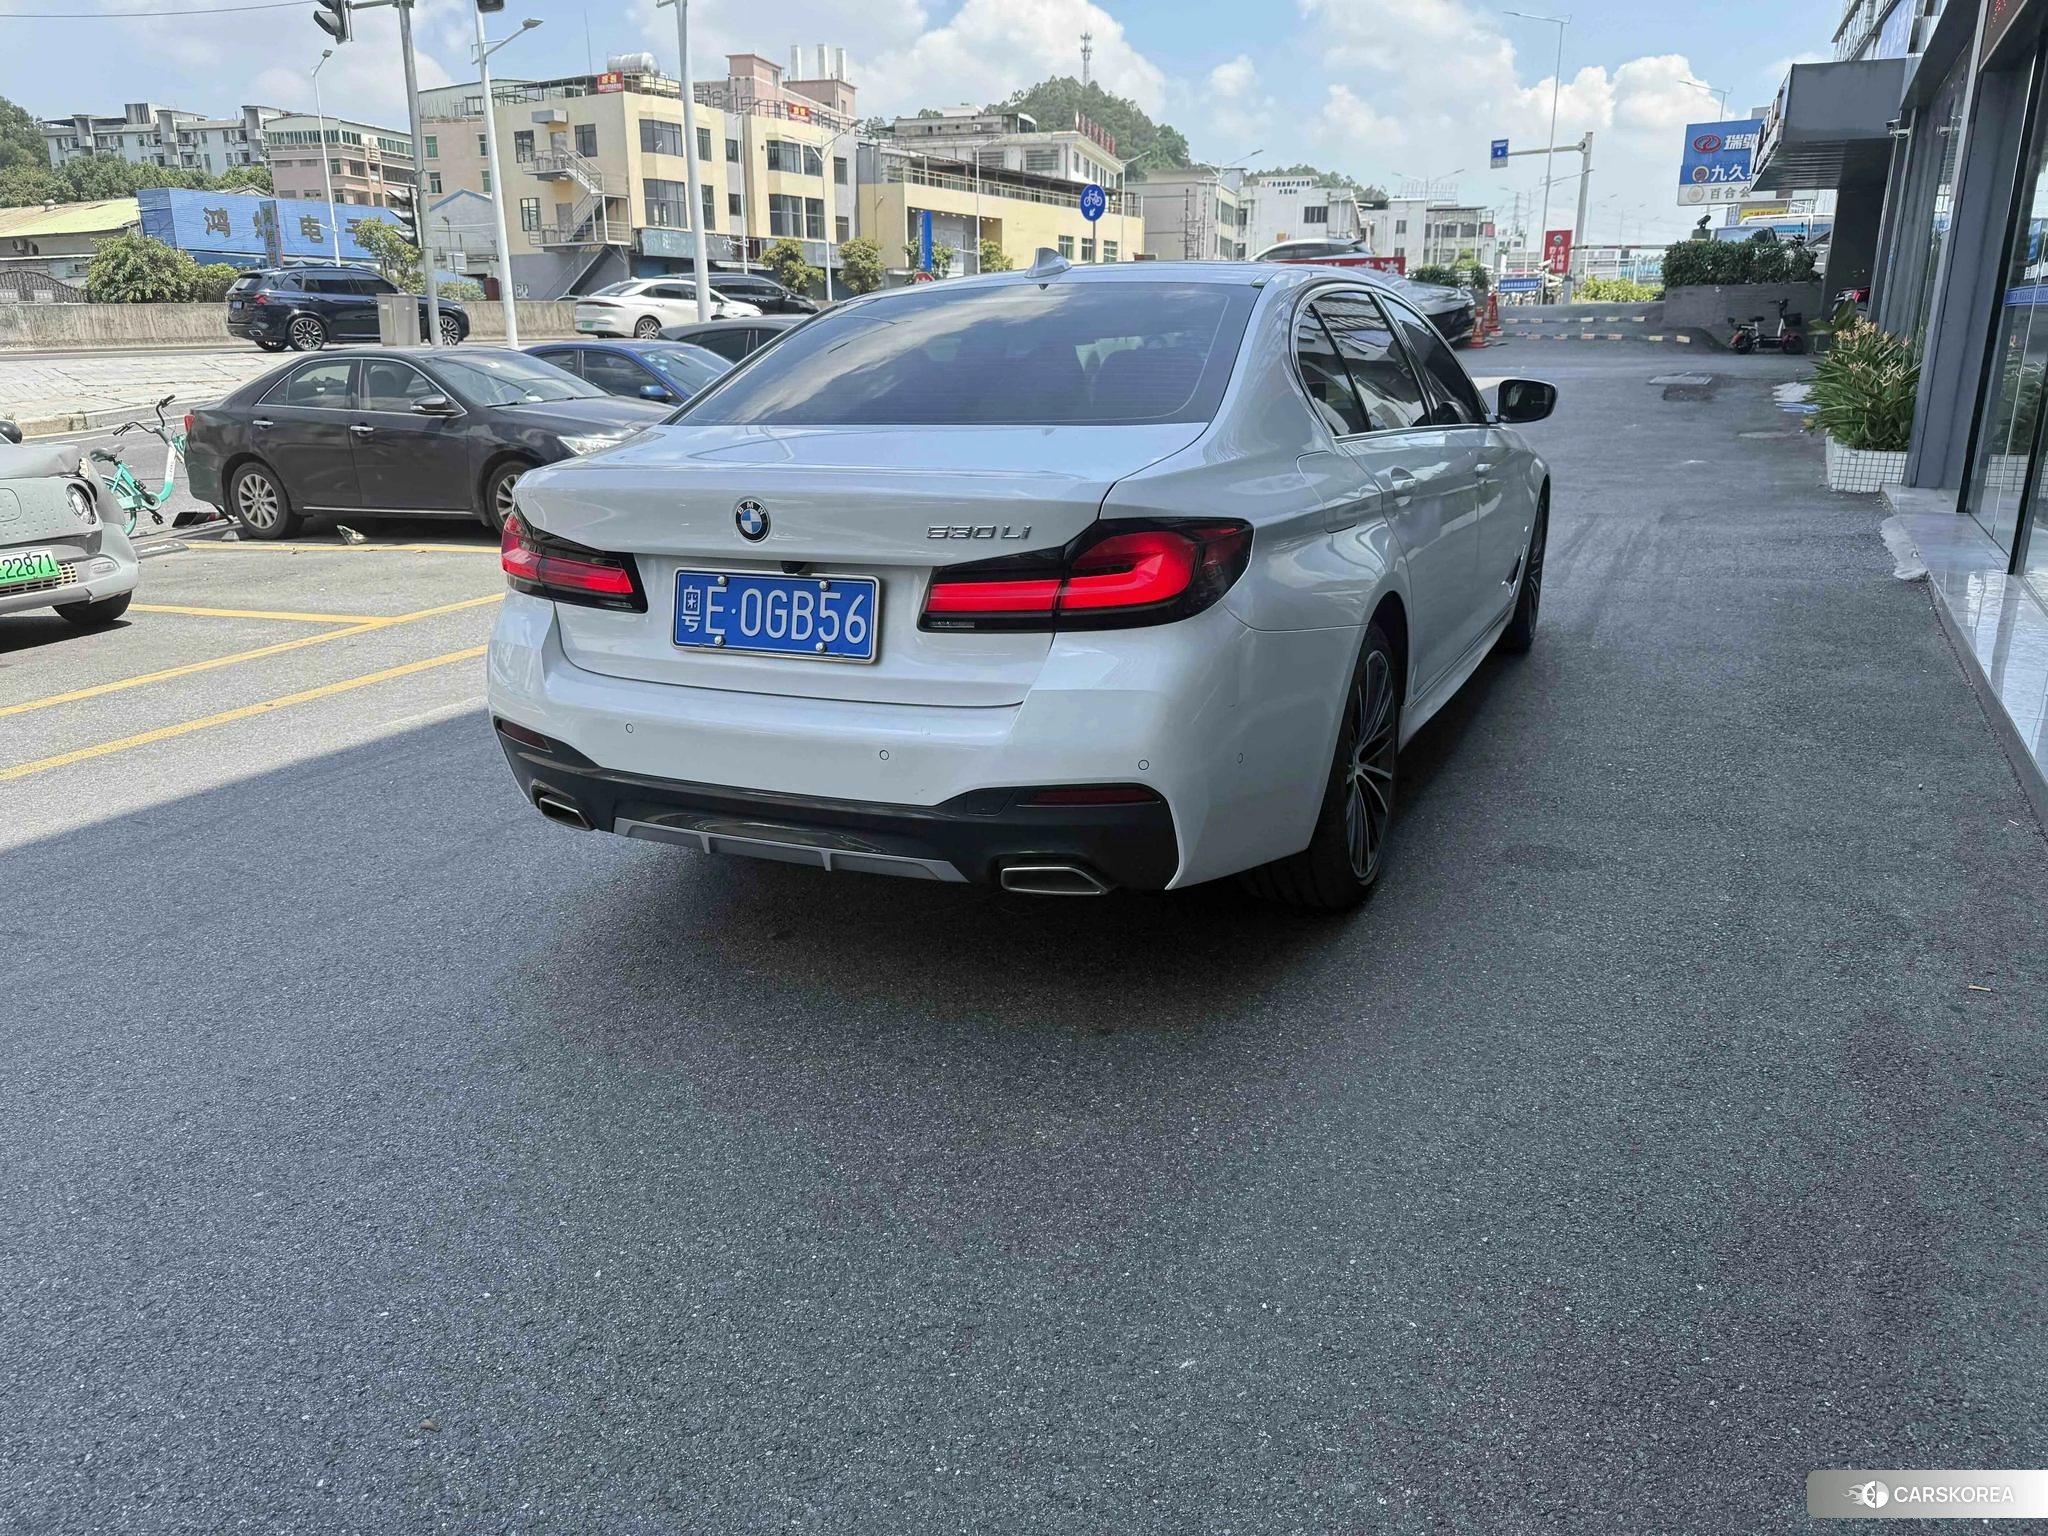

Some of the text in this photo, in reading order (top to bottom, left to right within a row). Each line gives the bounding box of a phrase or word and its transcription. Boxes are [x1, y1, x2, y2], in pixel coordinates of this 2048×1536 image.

[1711, 164, 1752, 182] 九久
[738, 501, 765, 515] BMW
[0, 553, 55, 580] 22871
